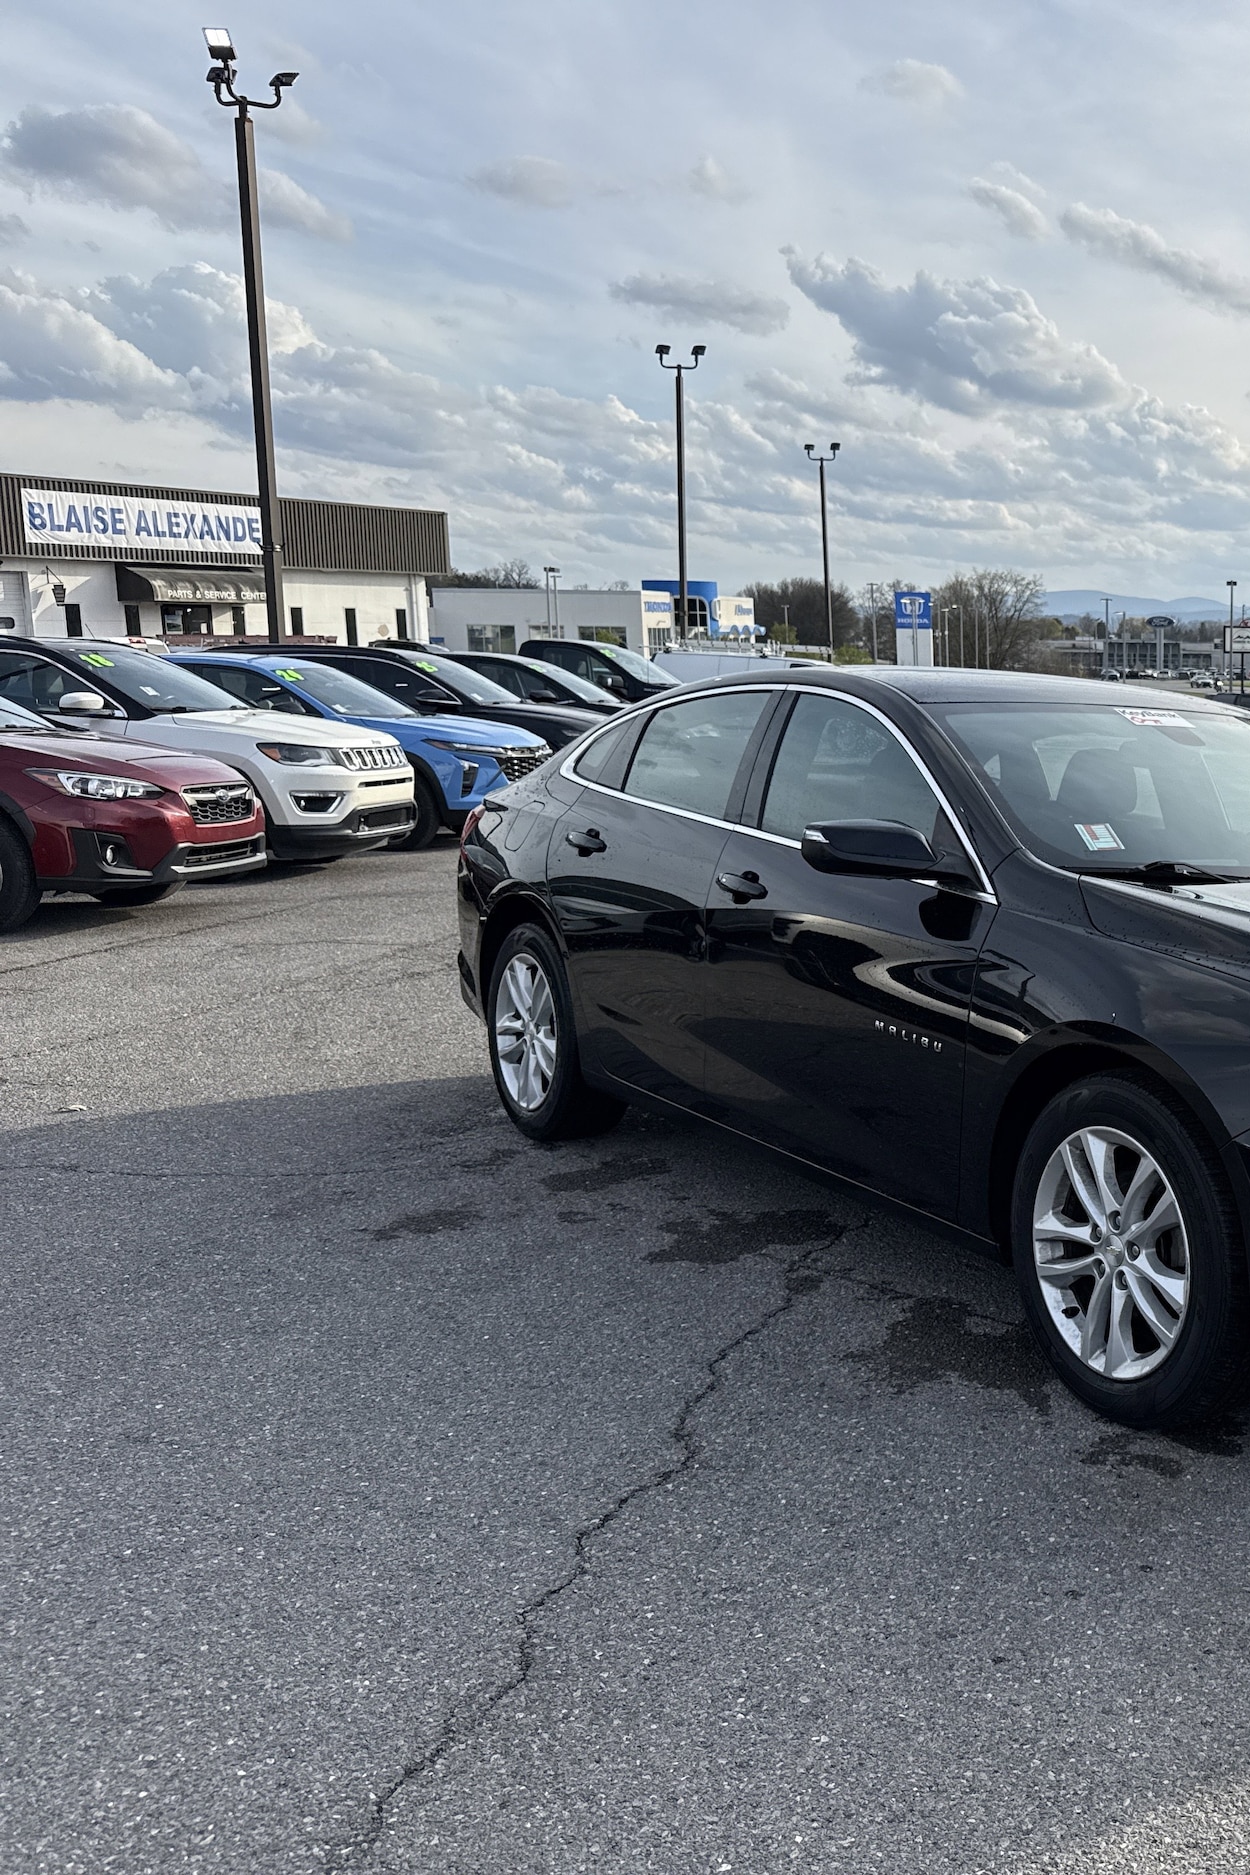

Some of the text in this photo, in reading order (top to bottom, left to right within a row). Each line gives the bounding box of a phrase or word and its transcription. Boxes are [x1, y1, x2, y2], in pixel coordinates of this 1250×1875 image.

[27, 502, 263, 544] BLAISE ALEXANDE
[167, 589, 267, 600] PARTS & SERVICE CENTE
[874, 1020, 942, 1053] MALIBU
